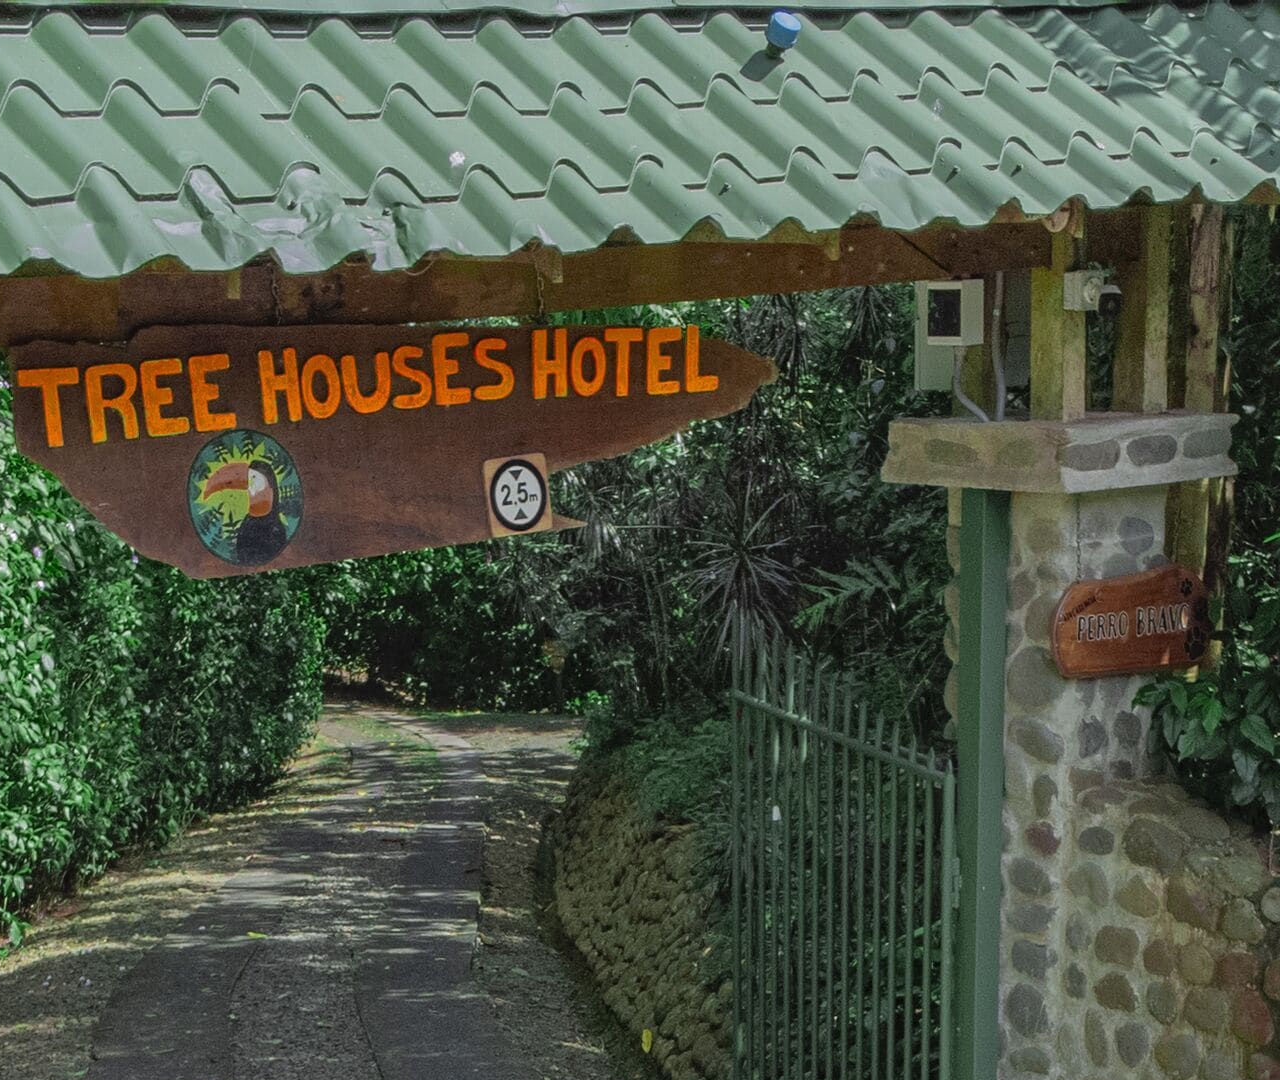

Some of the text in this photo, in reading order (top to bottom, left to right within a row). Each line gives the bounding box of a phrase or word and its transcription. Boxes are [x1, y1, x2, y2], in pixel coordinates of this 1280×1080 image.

[18, 324, 719, 447] TREE HOUSES HOTEL
[1076, 610, 1130, 642] PERRO
